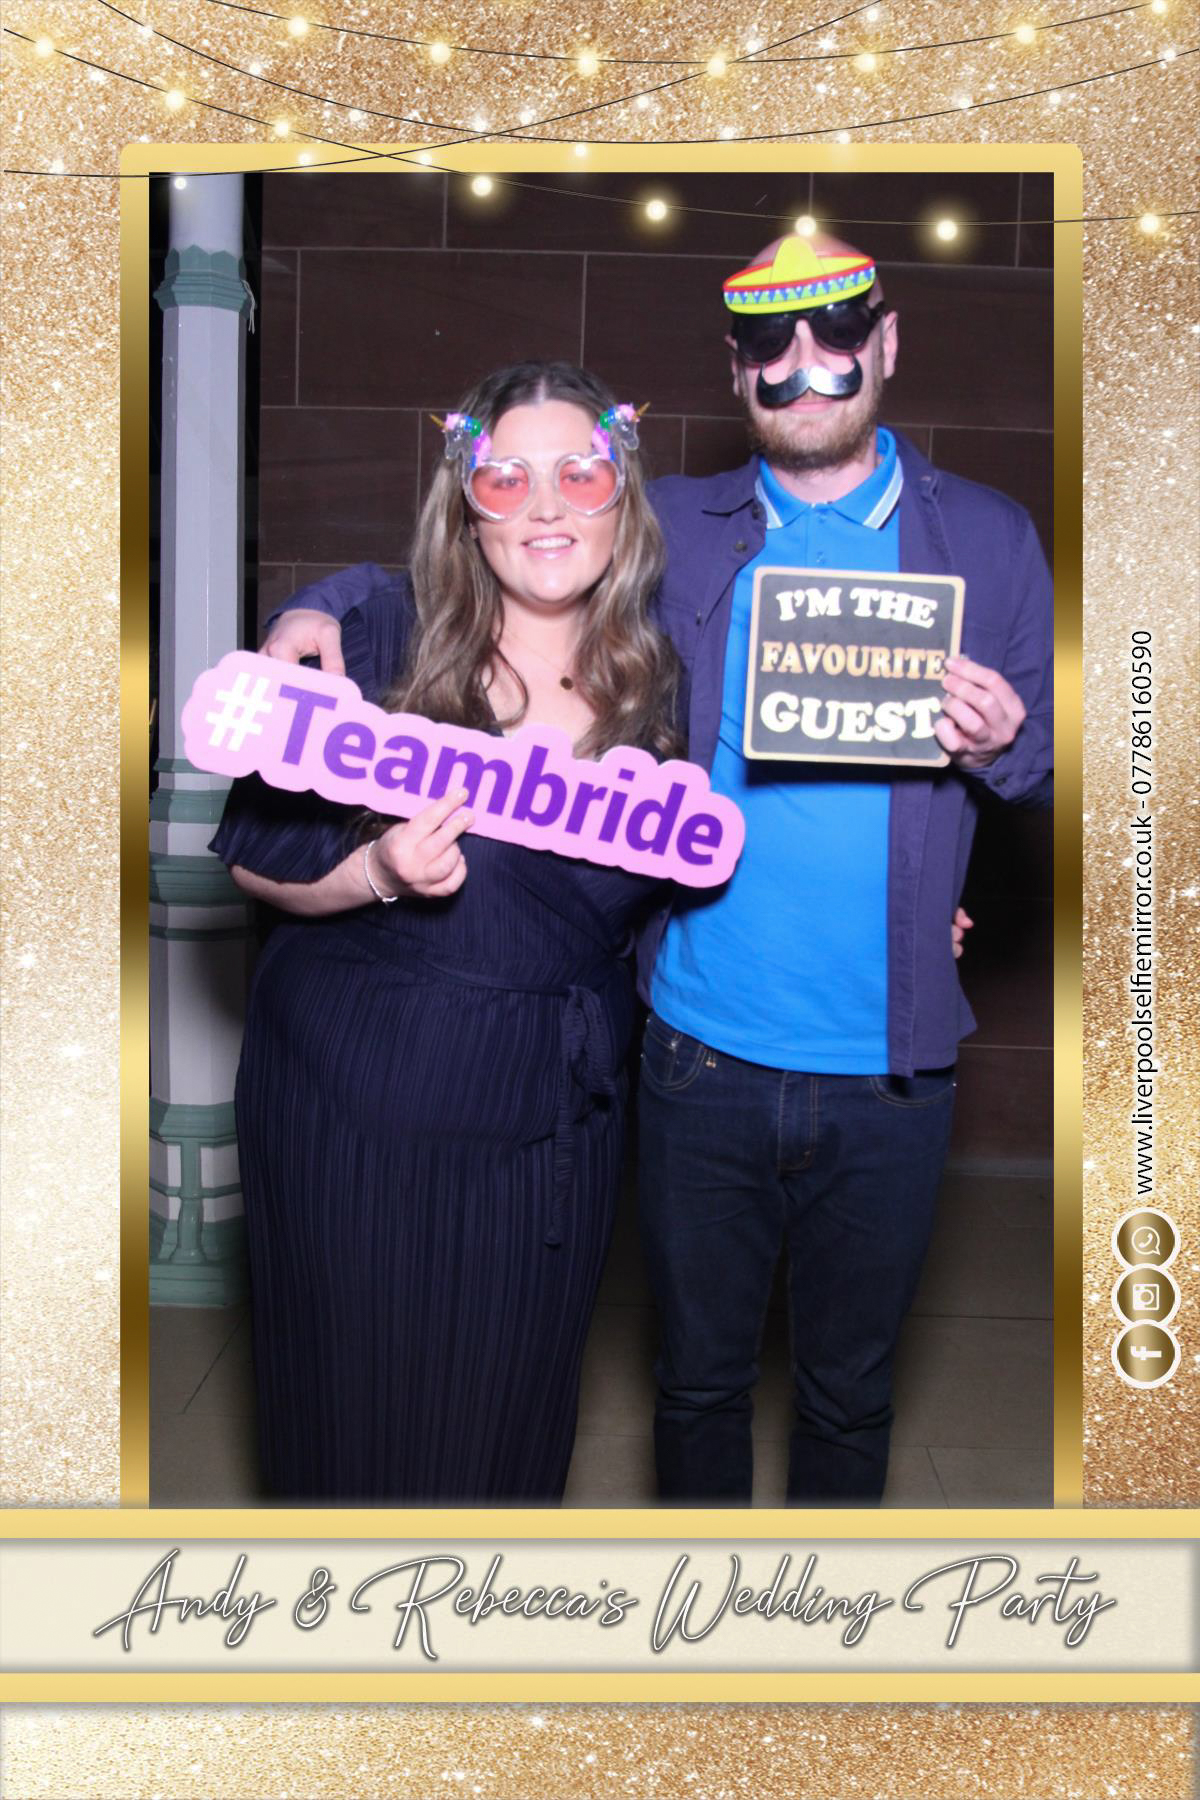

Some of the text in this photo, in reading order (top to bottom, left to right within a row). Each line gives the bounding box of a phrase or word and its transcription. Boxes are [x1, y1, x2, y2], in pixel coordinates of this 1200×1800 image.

[776, 587, 938, 629] I'M THE
[760, 641, 948, 681] FAVOURITE
[760, 691, 942, 742] GUEST
[205, 671, 724, 866] #Teambride
